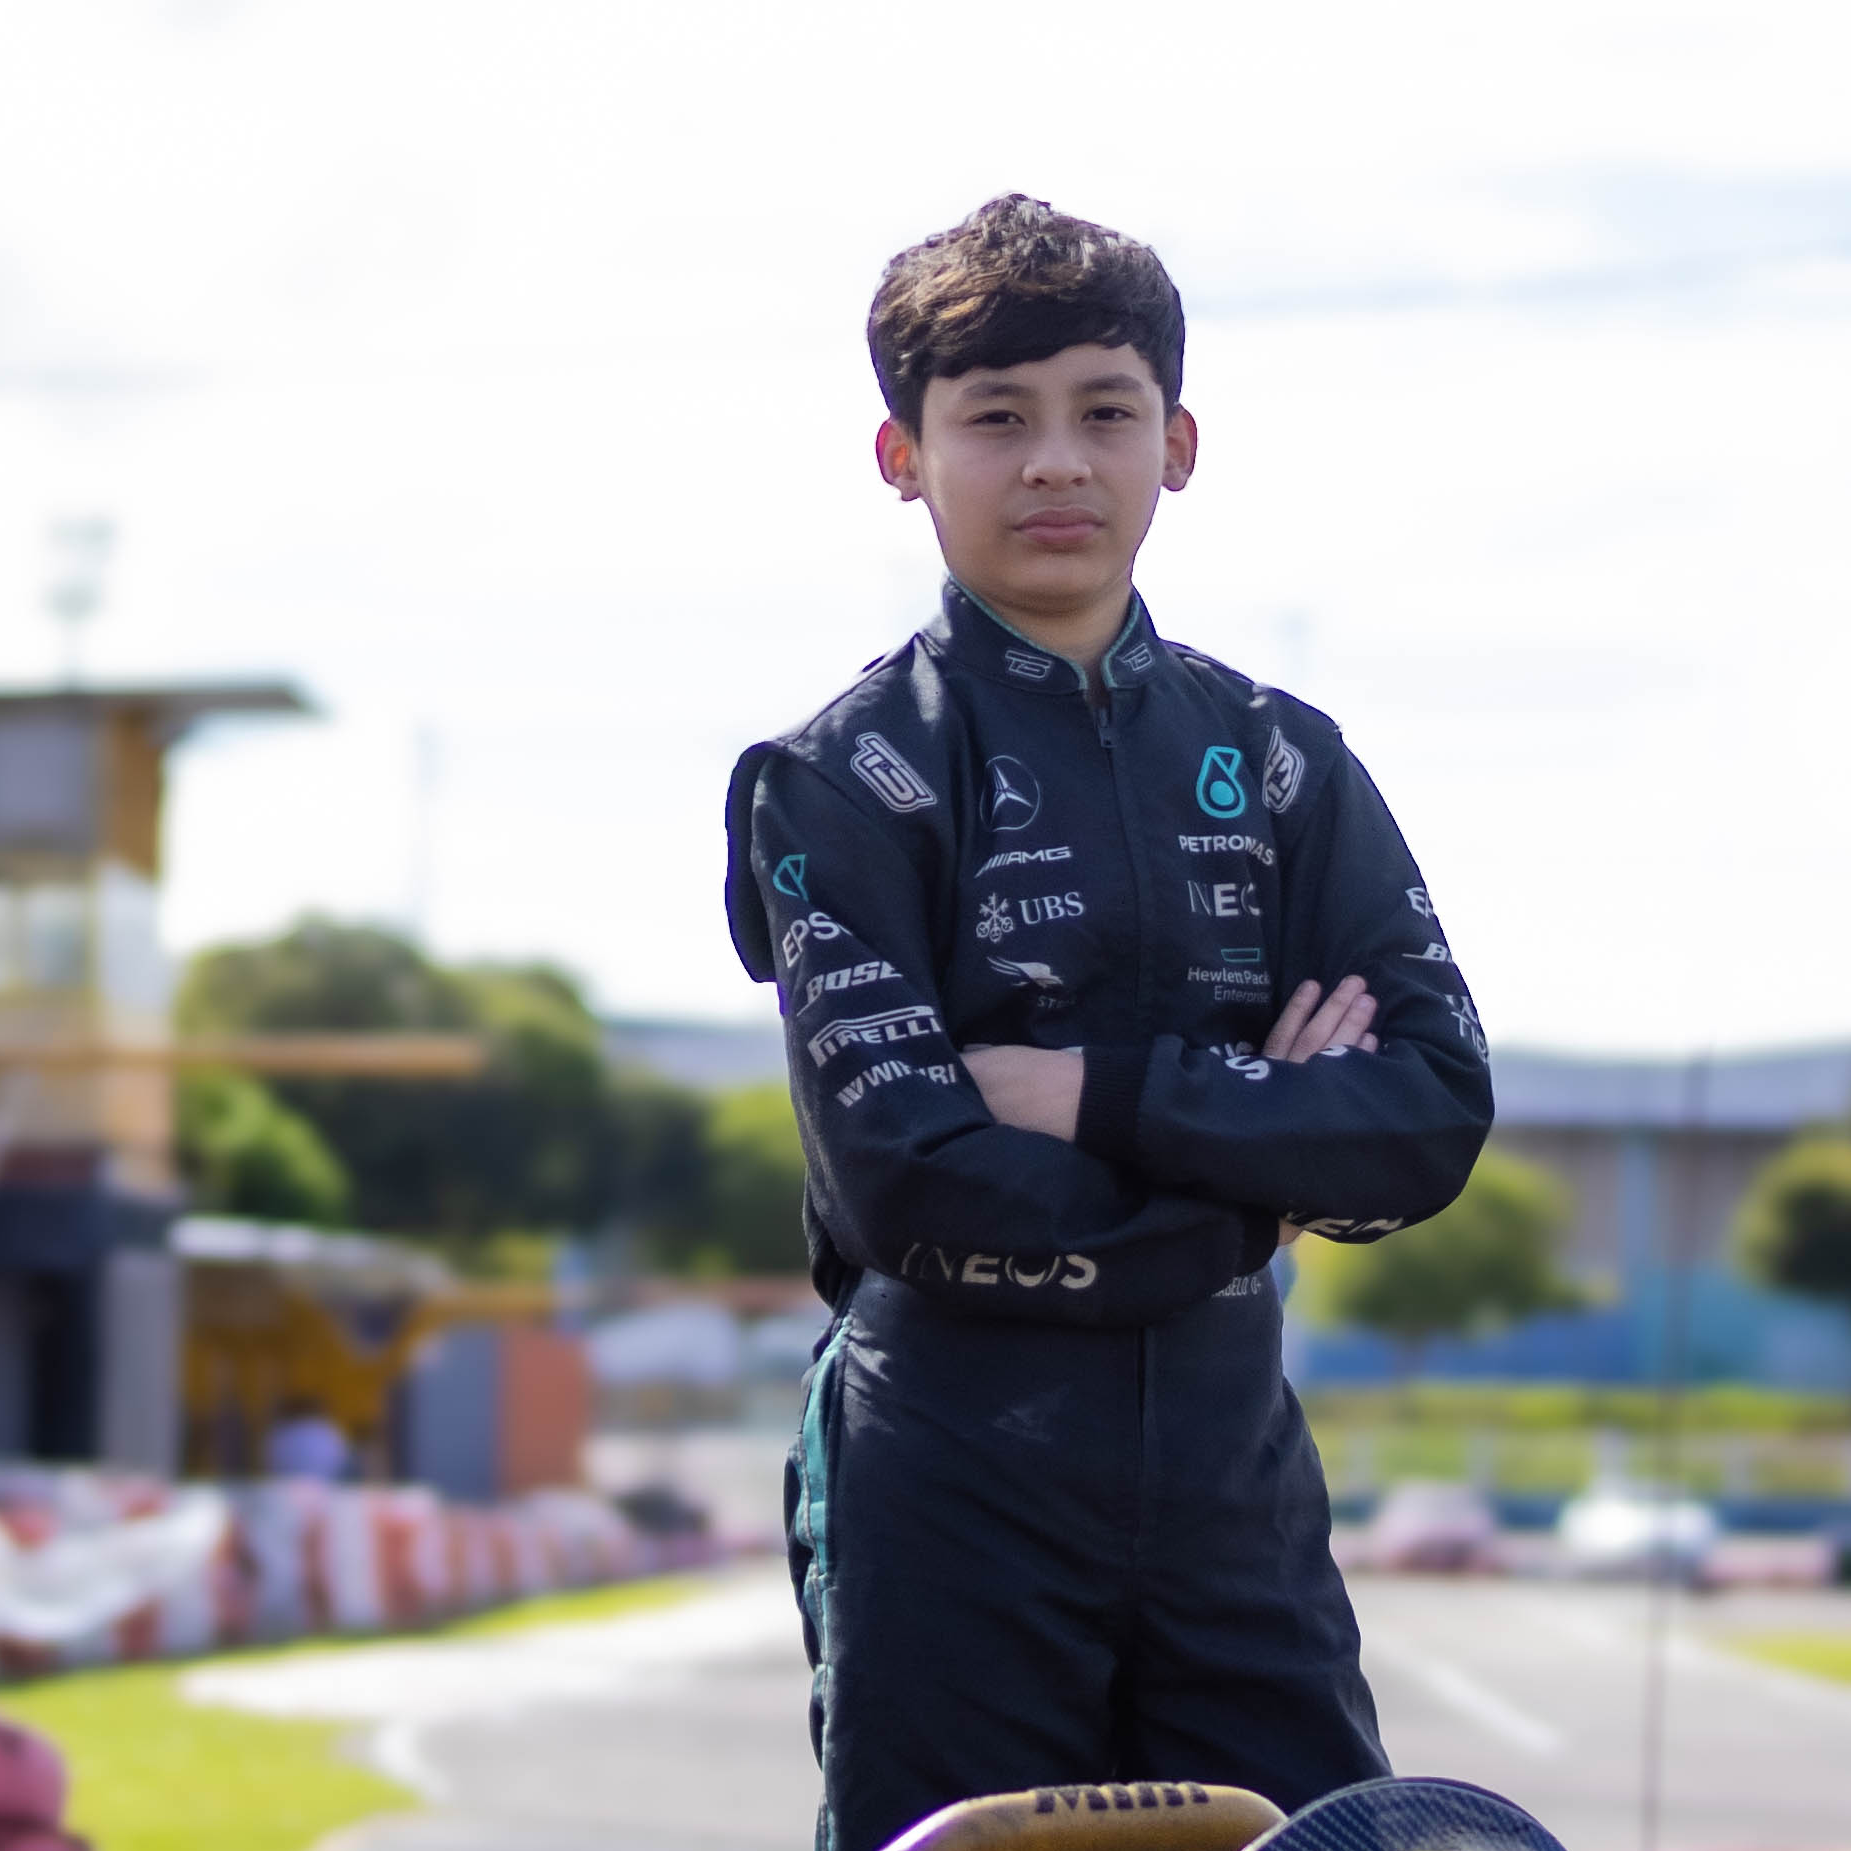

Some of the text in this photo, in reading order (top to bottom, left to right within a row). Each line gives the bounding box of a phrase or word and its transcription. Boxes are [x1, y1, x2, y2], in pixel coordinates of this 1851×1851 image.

[1178, 834, 1275, 866] PETRONAS
[1018, 891, 1085, 925] UBS
[807, 1005, 941, 1068] PIRELLI
[901, 1242, 1099, 1290] INEOS
